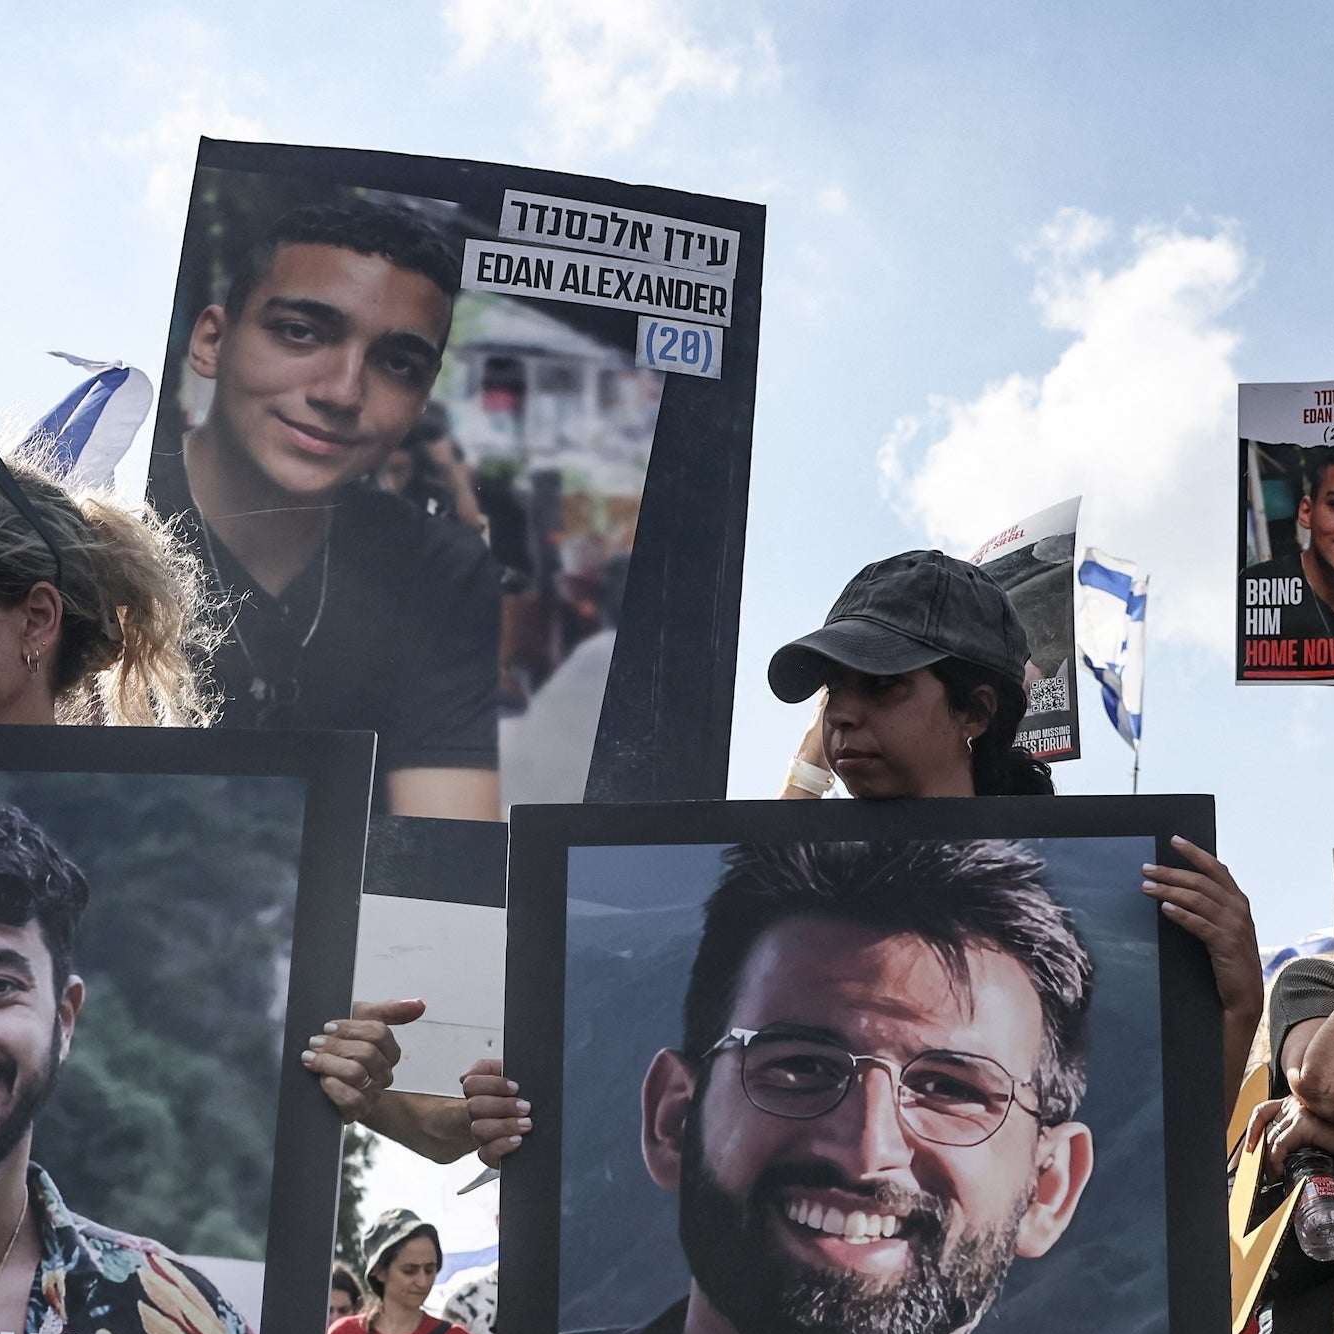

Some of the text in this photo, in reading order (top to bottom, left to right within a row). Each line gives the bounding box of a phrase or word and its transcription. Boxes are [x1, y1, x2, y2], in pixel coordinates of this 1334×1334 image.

[510, 200, 729, 266] עידן אלכסנדר
[477, 251, 728, 318] EDAN ALEXANDER
[645, 321, 713, 373] (20)
[1303, 407, 1332, 424] EDAN
[1245, 577, 1303, 606] BRING
[1245, 607, 1281, 635] HIM
[1245, 639, 1297, 667] HOME
[1038, 735, 1072, 752] FORUM
[1042, 725, 1070, 738] MISSING
